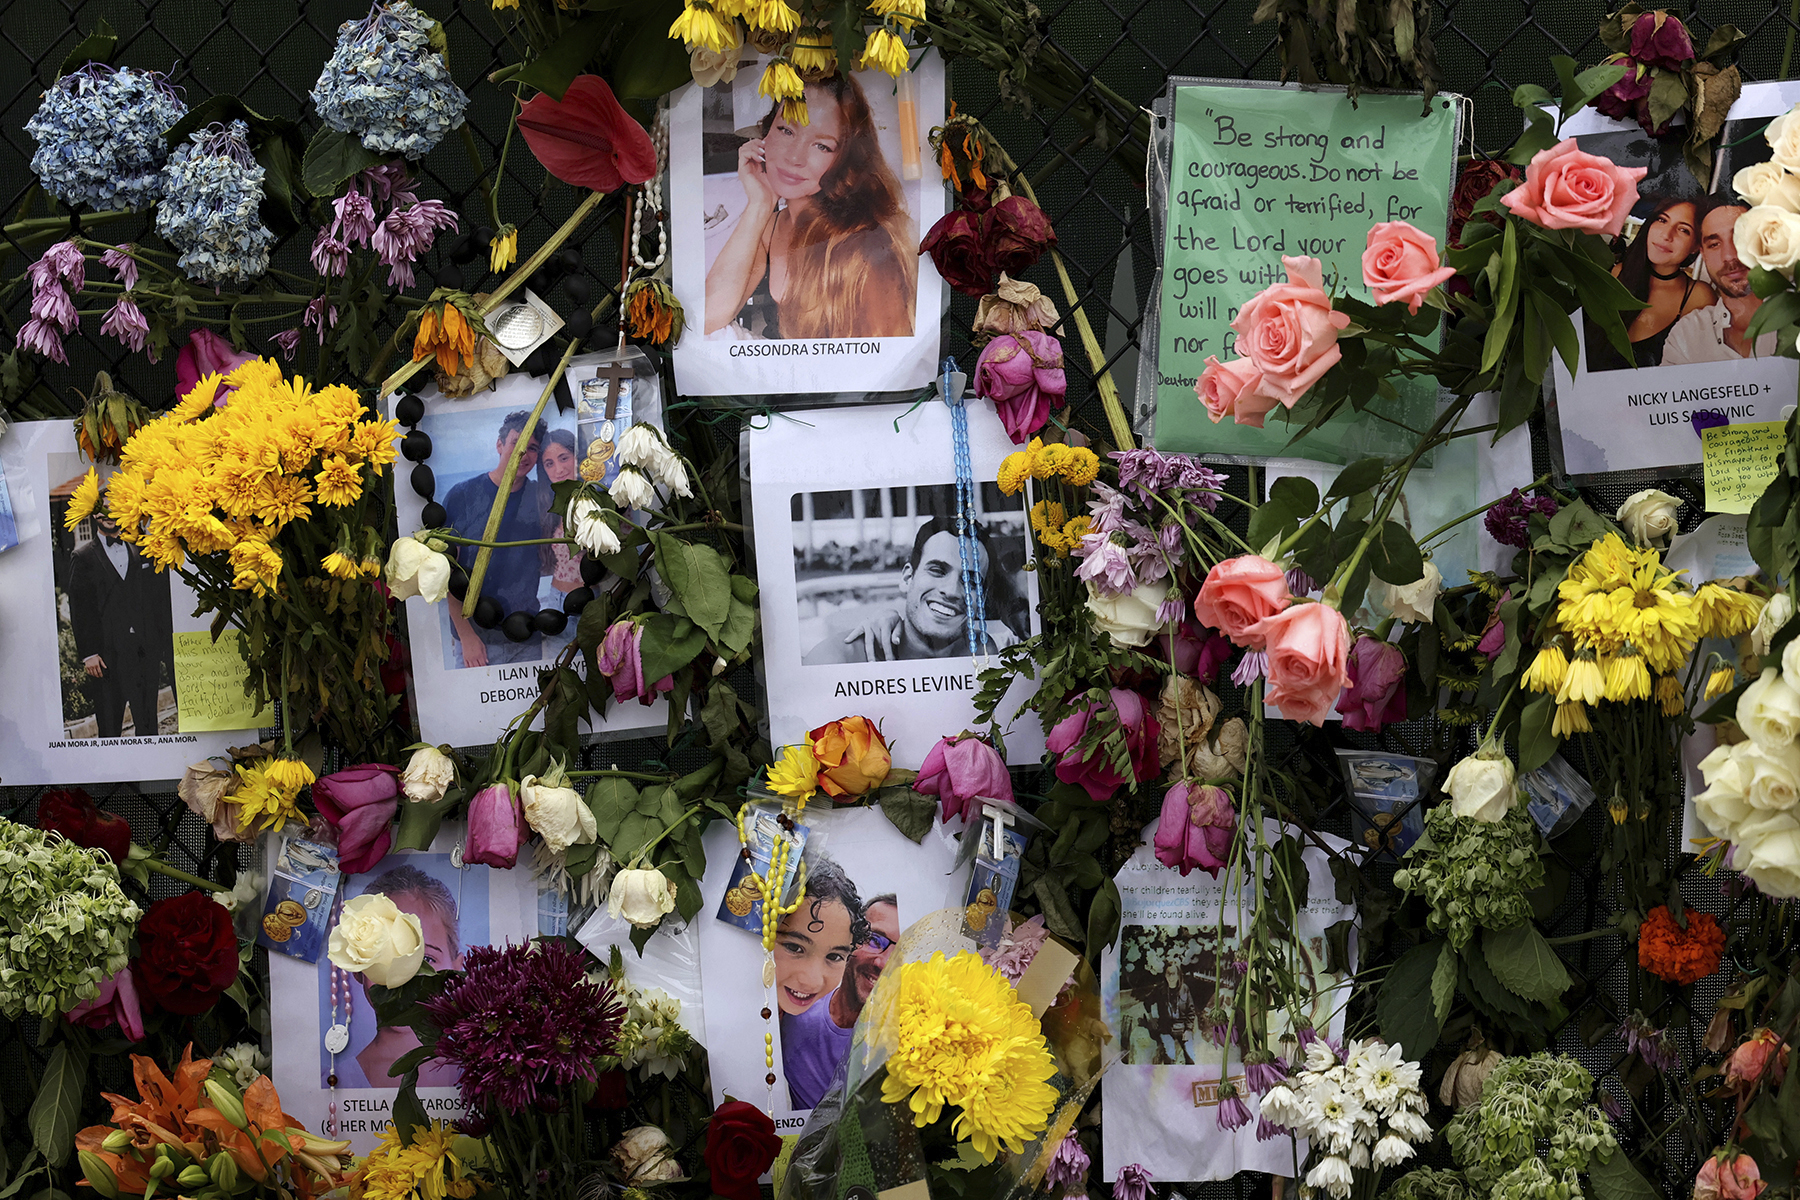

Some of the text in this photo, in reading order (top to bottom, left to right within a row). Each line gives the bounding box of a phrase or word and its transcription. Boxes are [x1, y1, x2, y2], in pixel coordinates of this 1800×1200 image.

[1264, 126, 1329, 163] strong
[1340, 125, 1386, 150] and
[1346, 161, 1383, 182] not
[1393, 160, 1419, 182] be
[1176, 188, 1423, 221] afraid or terrified, for
[1173, 227, 1346, 256] the Lord your
[1173, 267, 1229, 300] goes
[1239, 264, 1289, 285] with
[1179, 296, 1217, 320] will
[729, 341, 881, 357] CASSONDRA STRATTON
[1174, 336, 1209, 353] nor
[1627, 391, 1668, 408] NICKY
[1672, 382, 1760, 404] LANGESFELD
[1649, 404, 1756, 426] LUIS SADOVNIC
[1706, 432, 1719, 441] Be
[1752, 426, 1771, 435] and
[1706, 452, 1718, 460] be
[178, 635, 202, 648] Father
[174, 648, 199, 658] this
[210, 666, 230, 677] and
[498, 667, 529, 681] ILAN
[834, 674, 974, 698] ANDRES LEVINE
[480, 686, 541, 704] DEBORAH
[67, 740, 89, 748] MORA
[90, 739, 99, 748] JR,
[100, 739, 119, 747] JUAN
[120, 738, 142, 746] MORA
[158, 736, 173, 744] ANA
[174, 735, 198, 743] MORA
[1122, 885, 1138, 894] Her
[1140, 885, 1176, 895] children
[1177, 885, 1211, 896] tearfully
[1192, 898, 1213, 908] they
[1146, 910, 1158, 919] be
[1159, 910, 1183, 919] found
[1185, 910, 1209, 919] alive.
[343, 1099, 389, 1112] STELLA
[340, 1119, 370, 1132] HER
